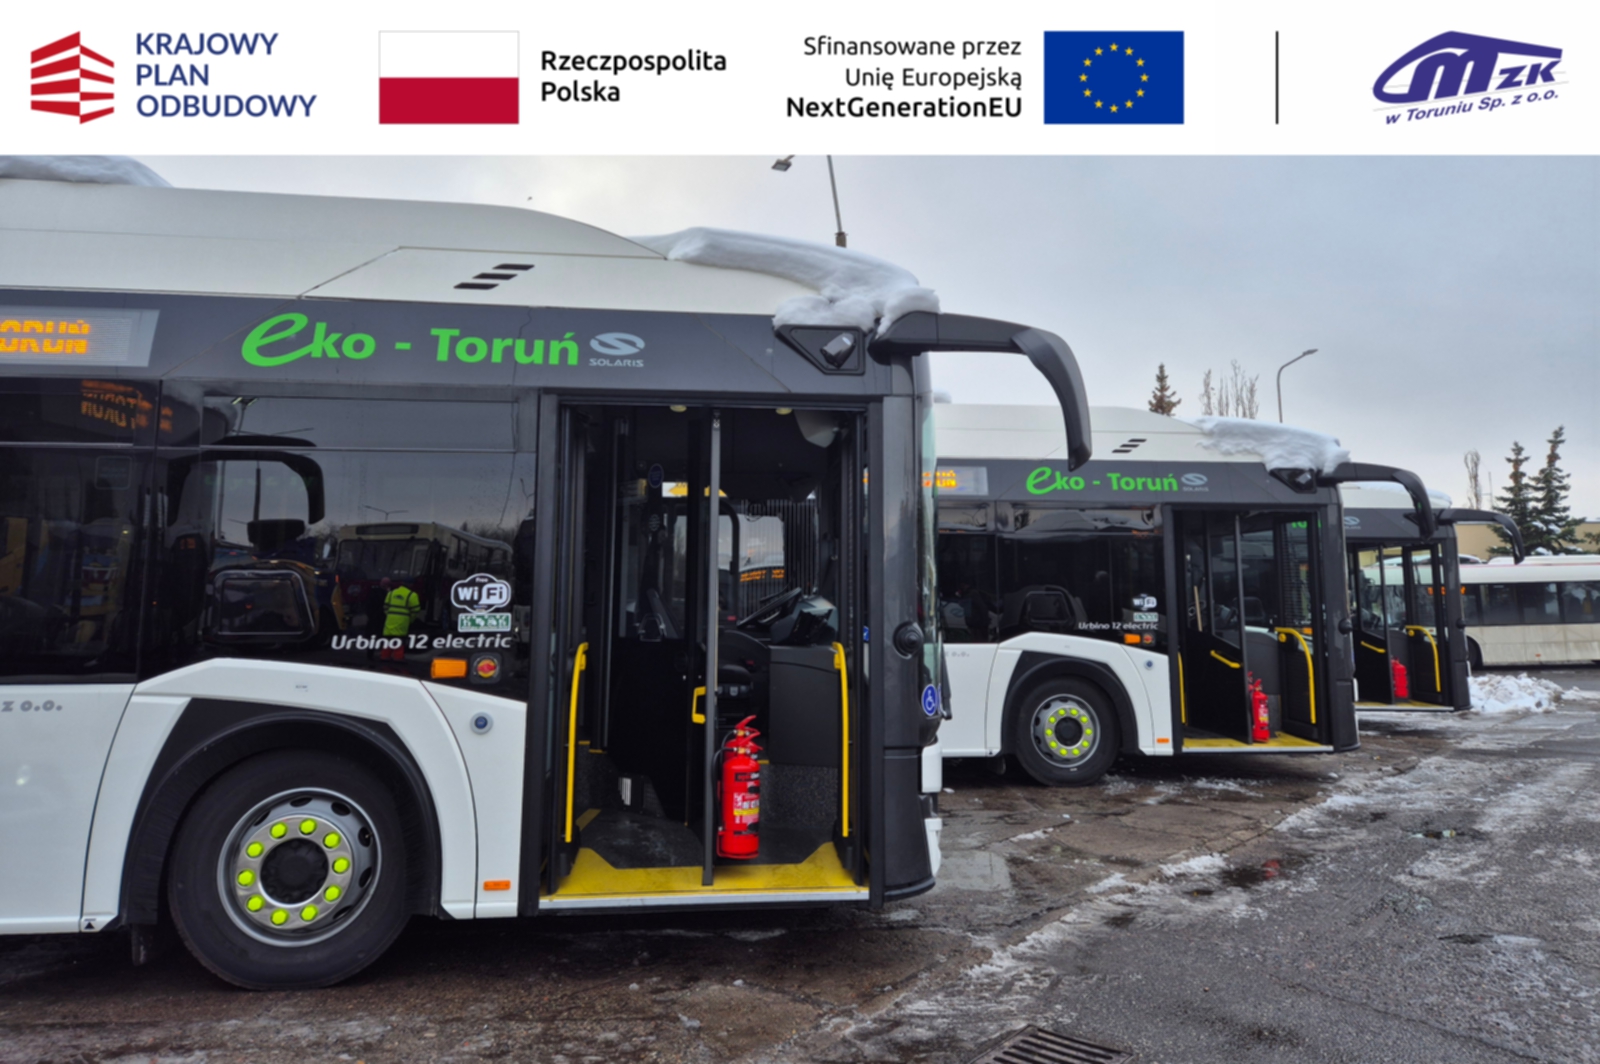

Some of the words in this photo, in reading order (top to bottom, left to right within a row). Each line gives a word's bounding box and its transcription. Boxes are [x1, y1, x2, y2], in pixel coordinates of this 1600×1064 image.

[241, 312, 377, 368] eko
[395, 341, 412, 351] -
[430, 327, 580, 367] Toruń
[589, 358, 645, 368] SOLARIS
[1025, 466, 1086, 496] eko
[1106, 473, 1179, 492] Toruń
[1078, 622, 1110, 630] Urbino
[1112, 622, 1122, 630] 12
[1122, 622, 1159, 630] electric
[331, 635, 402, 650] Urbino
[408, 634, 429, 649] 12
[432, 633, 512, 649] electric
